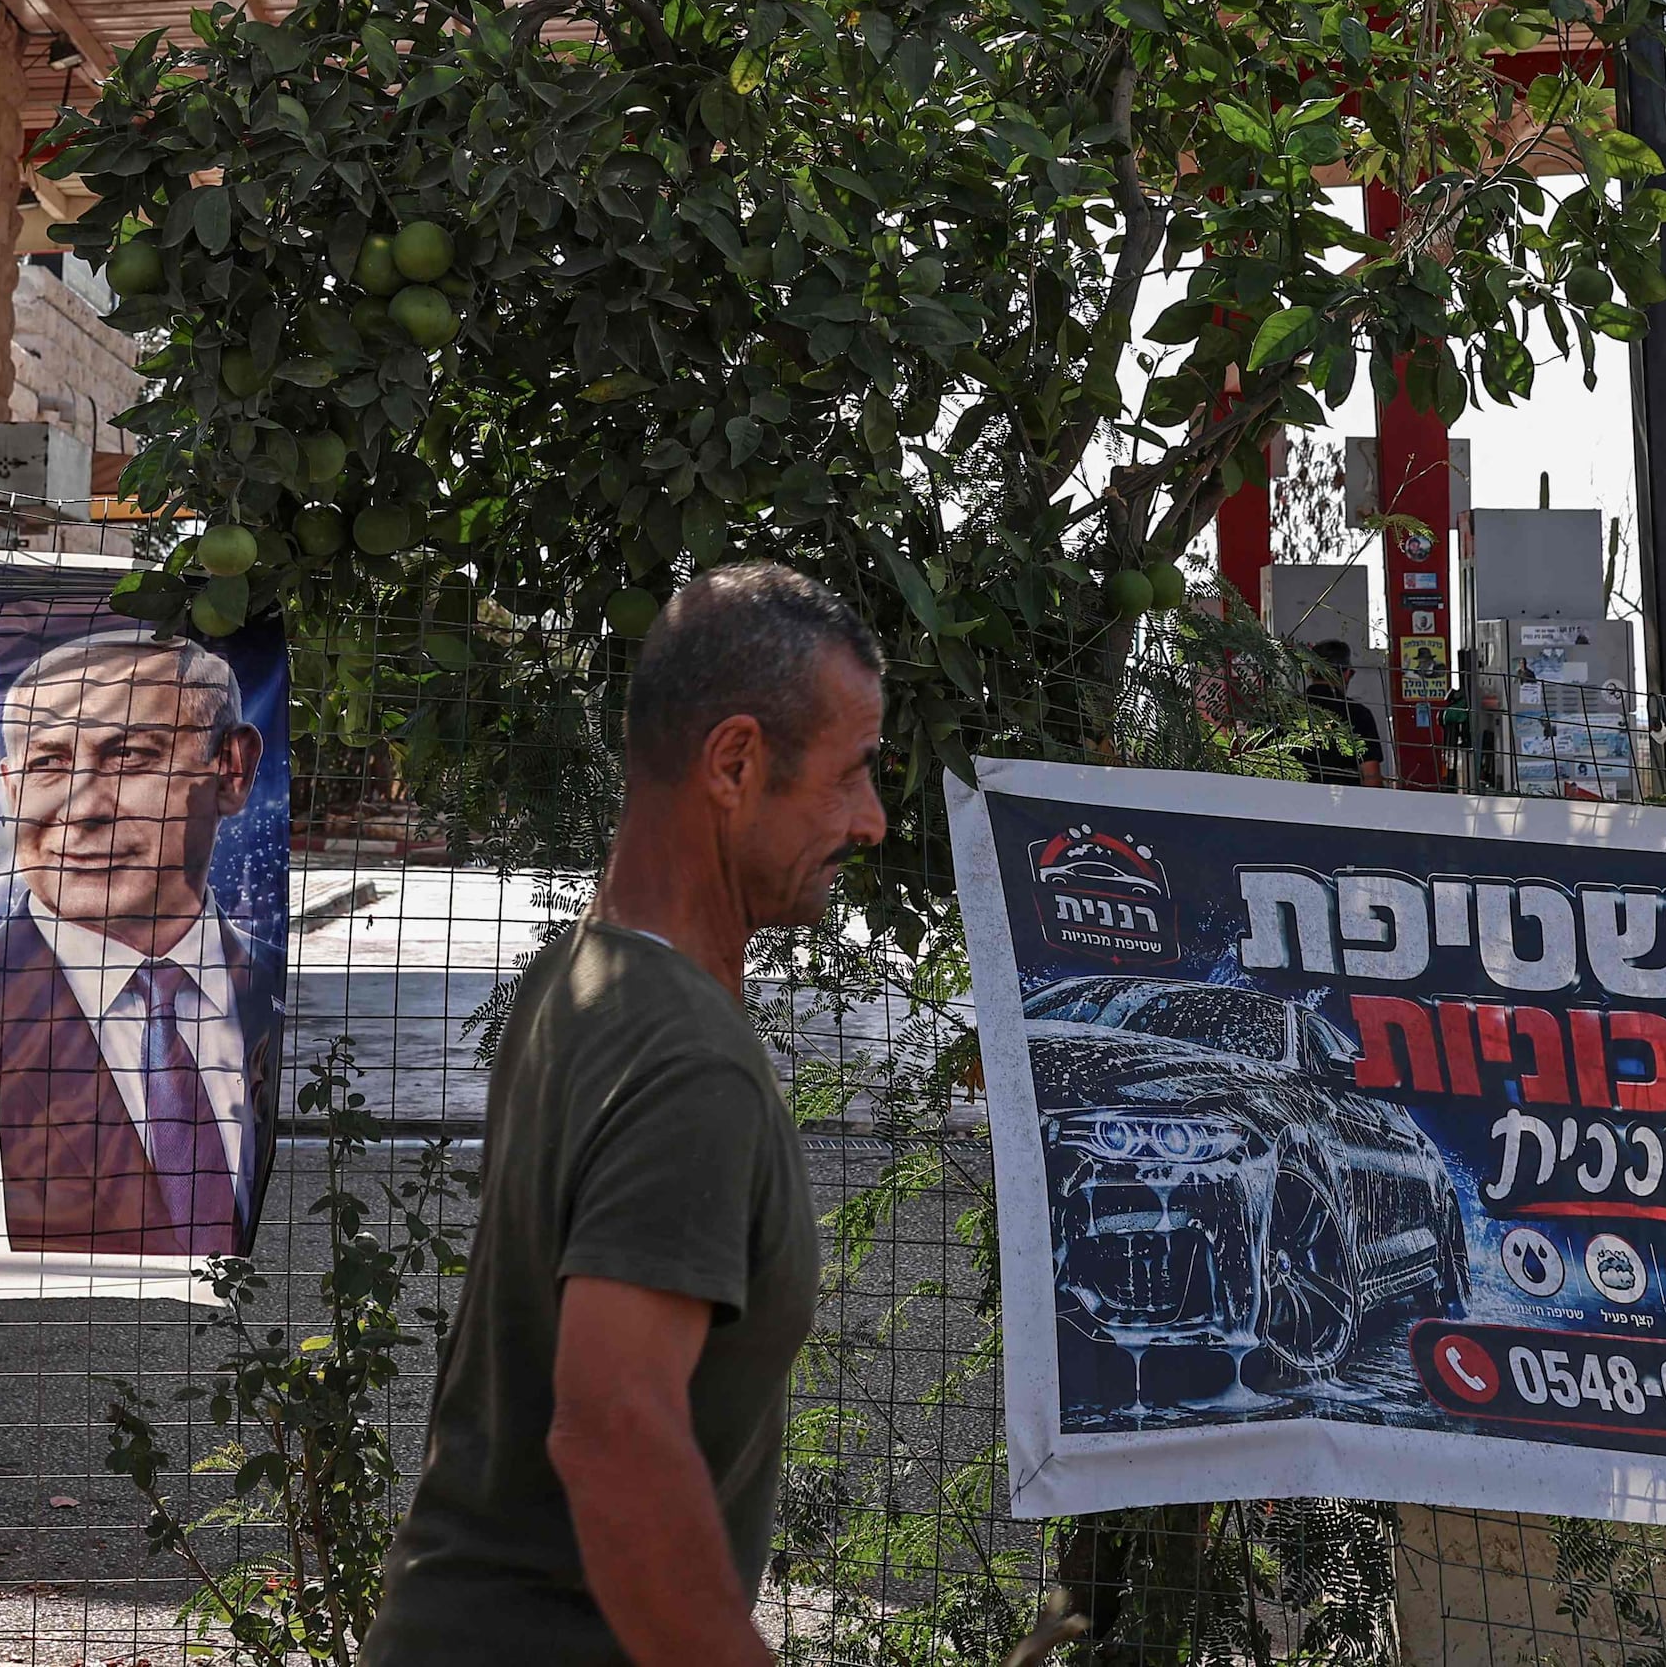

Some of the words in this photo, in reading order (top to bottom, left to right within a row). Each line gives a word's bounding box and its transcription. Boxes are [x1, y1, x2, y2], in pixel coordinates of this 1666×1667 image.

[1055, 894, 1160, 933] רננית
[1060, 928, 1112, 948] מכוניות
[1114, 937, 1163, 954] שטיפת
[1600, 1308, 1628, 1324] פעיל
[1630, 1312, 1654, 1328] קצף
